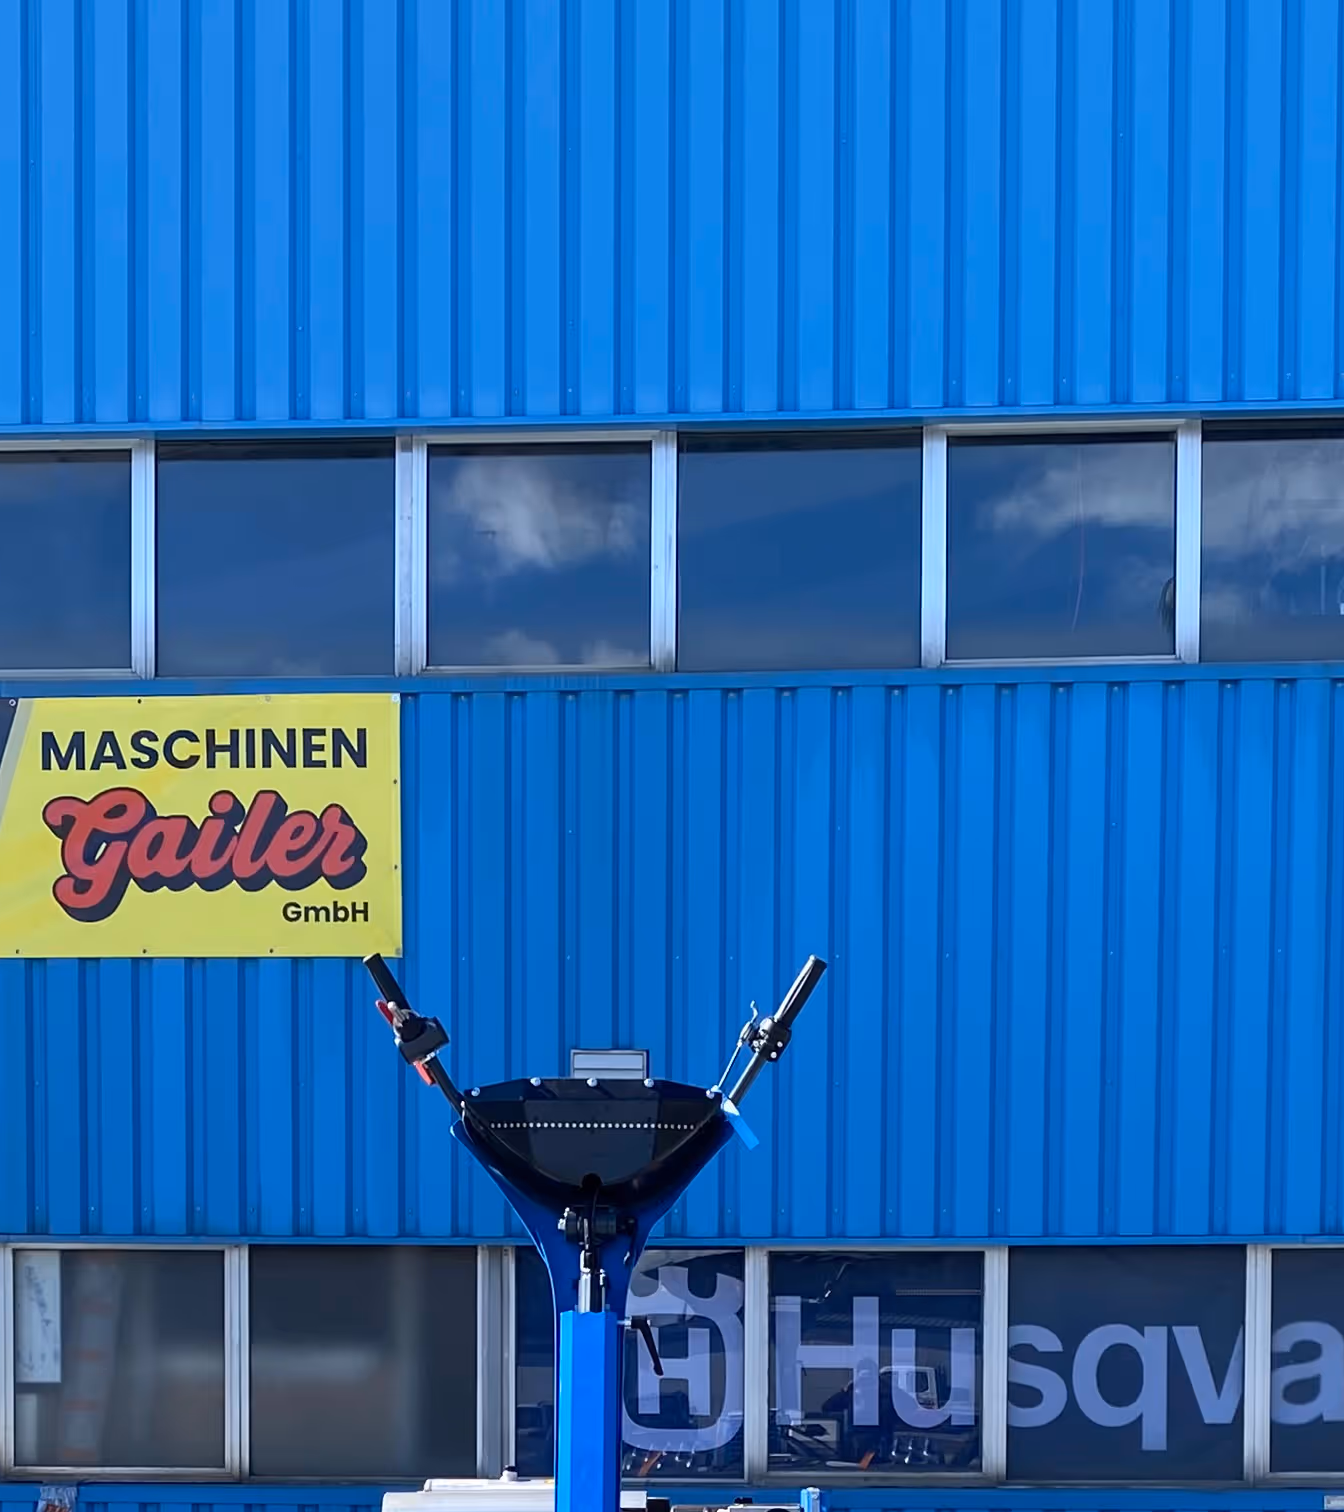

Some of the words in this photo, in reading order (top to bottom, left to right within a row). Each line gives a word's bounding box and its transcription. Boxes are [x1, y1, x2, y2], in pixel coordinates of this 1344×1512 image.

[41, 728, 367, 770] MASCHINEN
[42, 787, 368, 923] Gailer
[282, 901, 369, 923] GmbH
